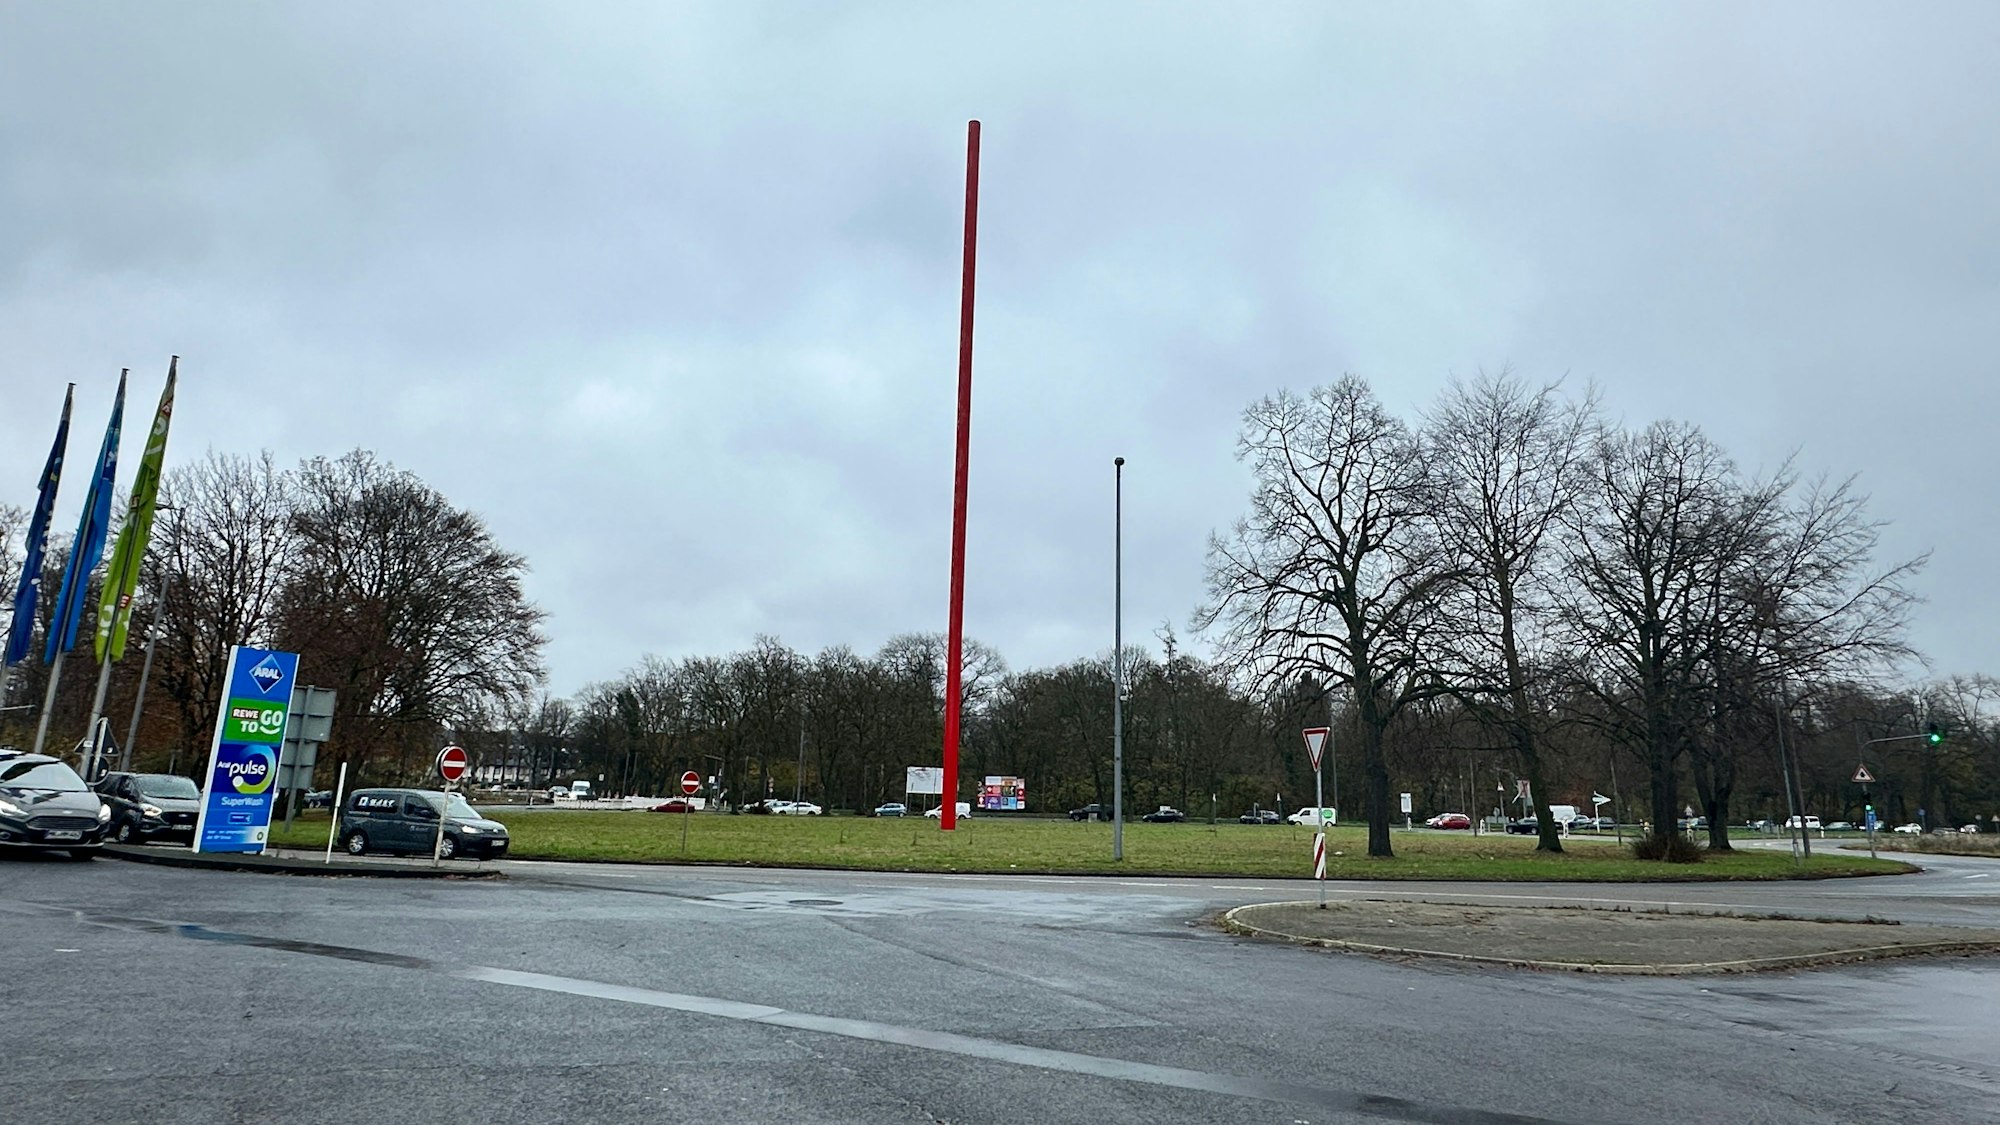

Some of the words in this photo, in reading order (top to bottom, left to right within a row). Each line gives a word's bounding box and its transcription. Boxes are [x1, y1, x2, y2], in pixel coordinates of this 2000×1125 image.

[254, 667, 280, 680] ARAL
[233, 708, 259, 719] REWE
[240, 720, 259, 733] TO
[260, 709, 284, 727] GO
[228, 760, 266, 777] pulse
[221, 796, 264, 807] SuperWash
